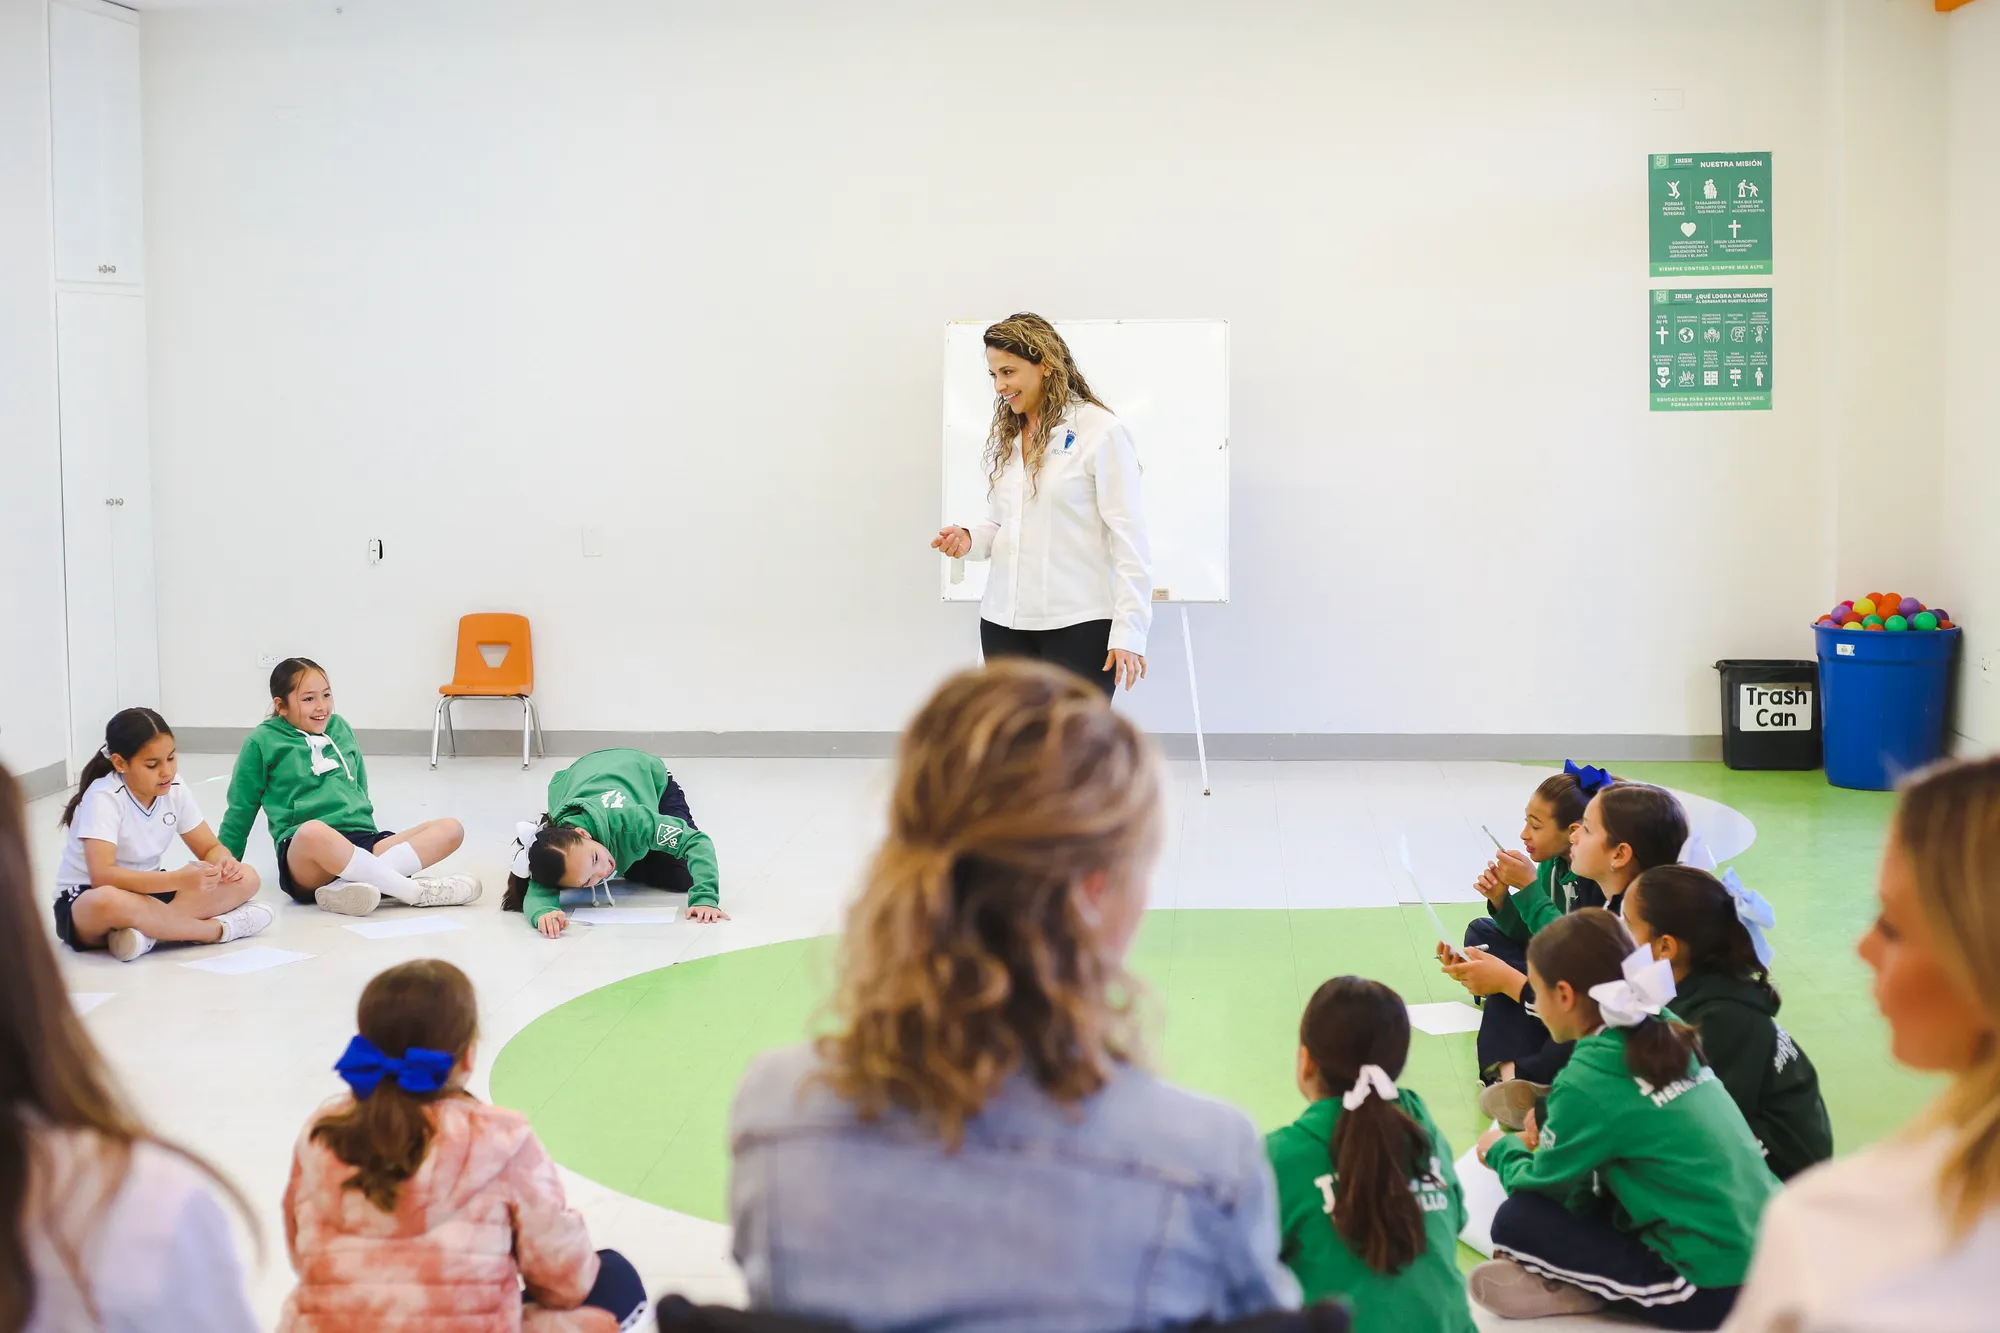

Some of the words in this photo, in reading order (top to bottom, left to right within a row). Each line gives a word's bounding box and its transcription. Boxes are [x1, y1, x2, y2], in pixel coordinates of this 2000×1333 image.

[1736, 159, 1762, 167] MISIÓN
[1746, 686, 1807, 705] Trash
[1756, 708, 1796, 727] Can
